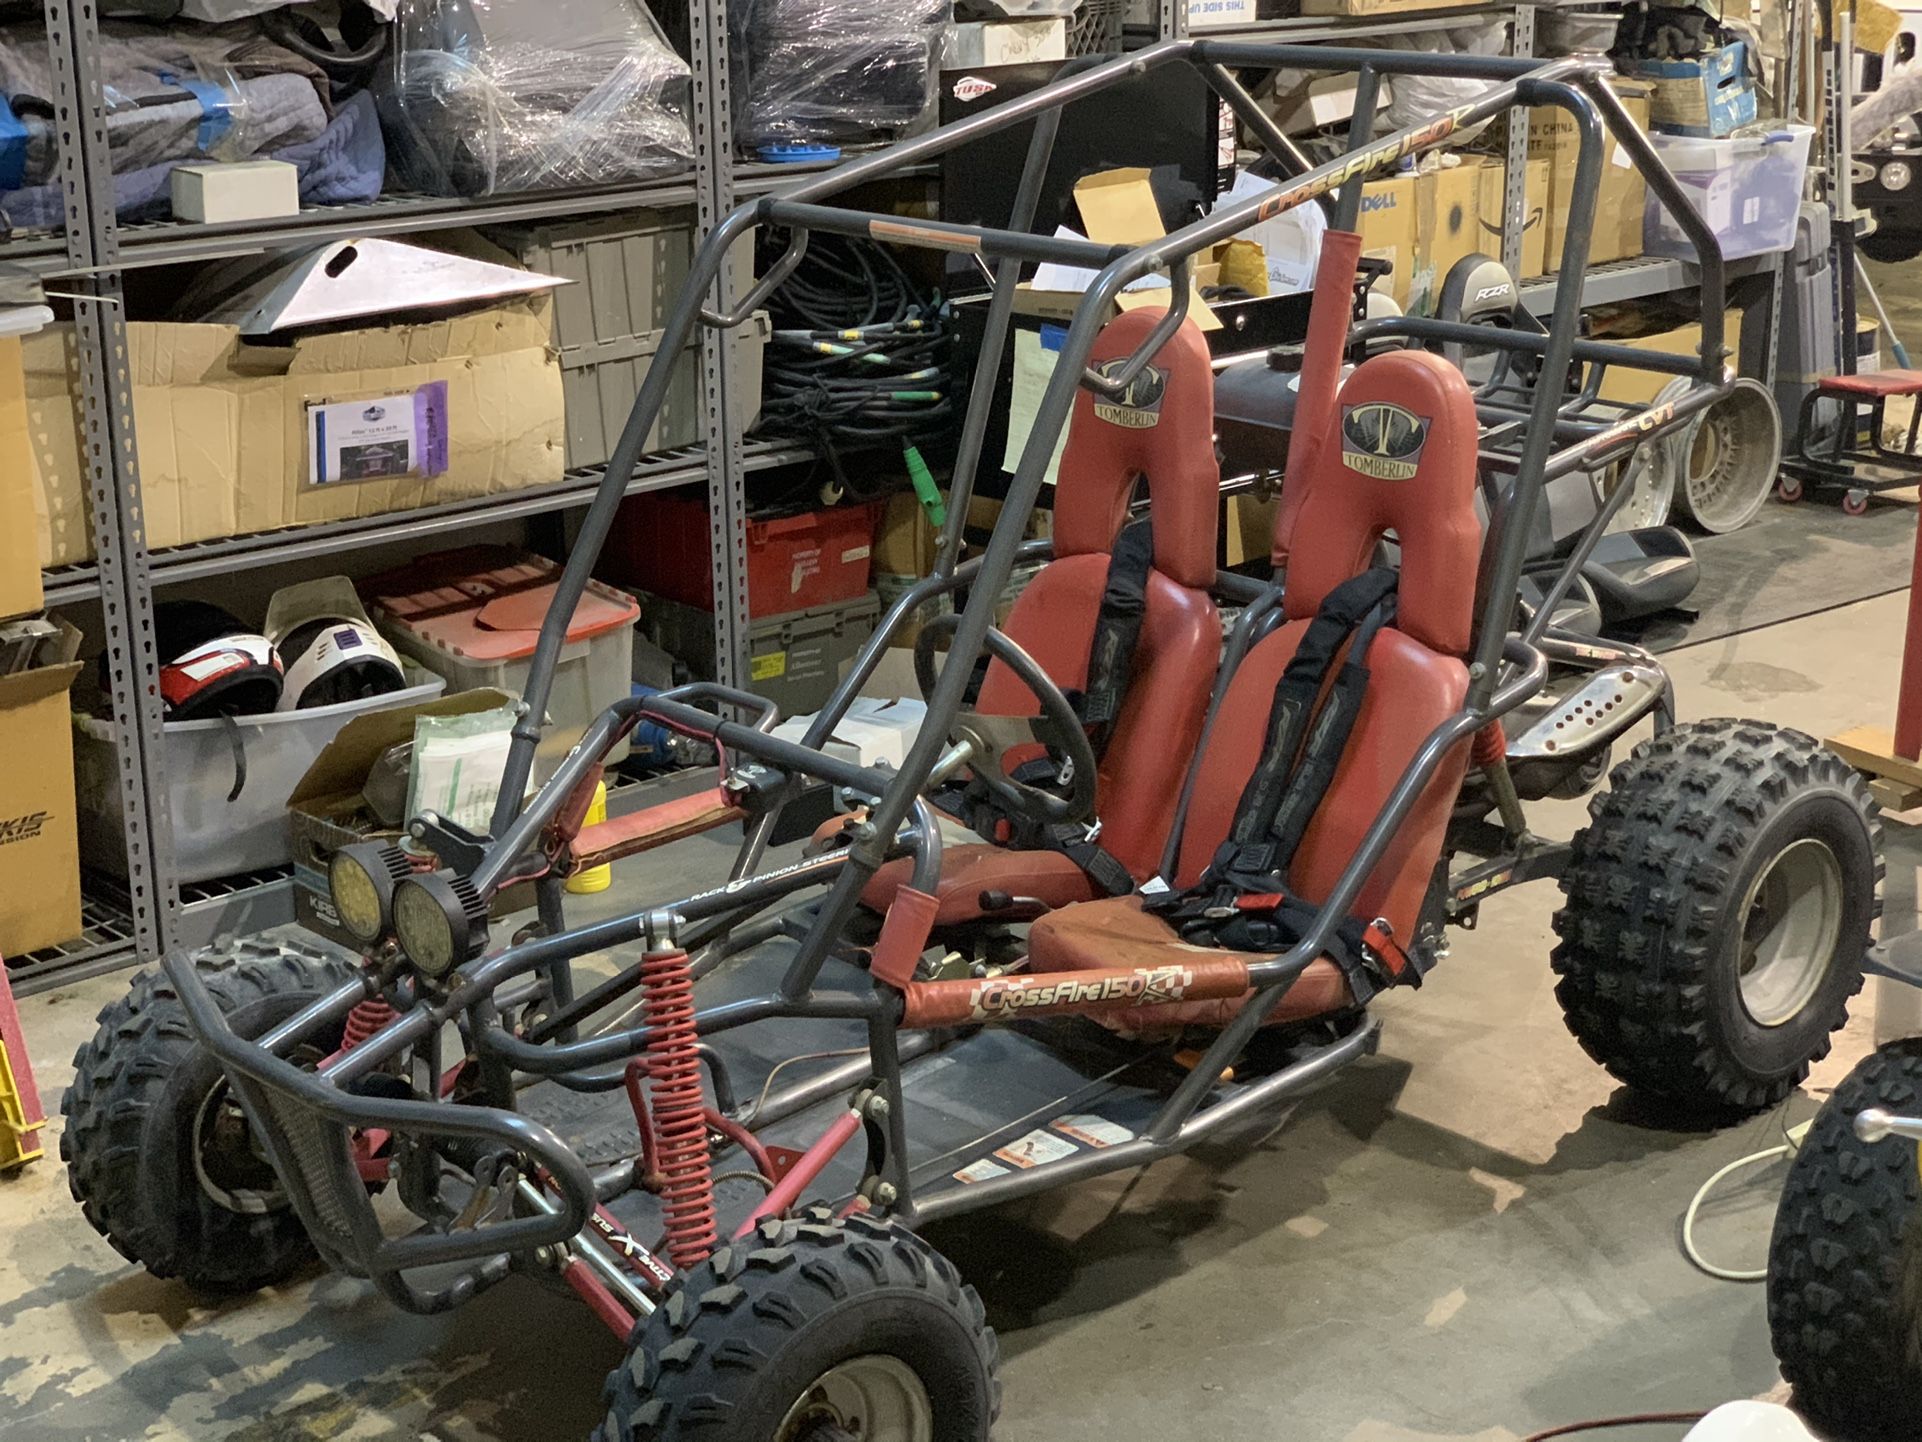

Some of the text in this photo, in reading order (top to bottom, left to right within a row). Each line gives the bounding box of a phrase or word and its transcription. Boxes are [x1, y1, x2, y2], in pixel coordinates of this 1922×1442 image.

[1203, 3, 1224, 13] SIDE
[1226, 1, 1246, 11] THIS
[1542, 121, 1575, 136] CHINA
[1360, 191, 1397, 213] DELL
[1474, 282, 1511, 302] RZR
[1096, 404, 1158, 428] TOMBERLIN
[1345, 453, 1416, 479] TOMBERLIN
[690, 885, 726, 902] RACK
[752, 863, 799, 883] PINION
[803, 848, 850, 869] STEERI
[309, 895, 337, 918] KIRB
[638, 1254, 672, 1281] CTIVE
